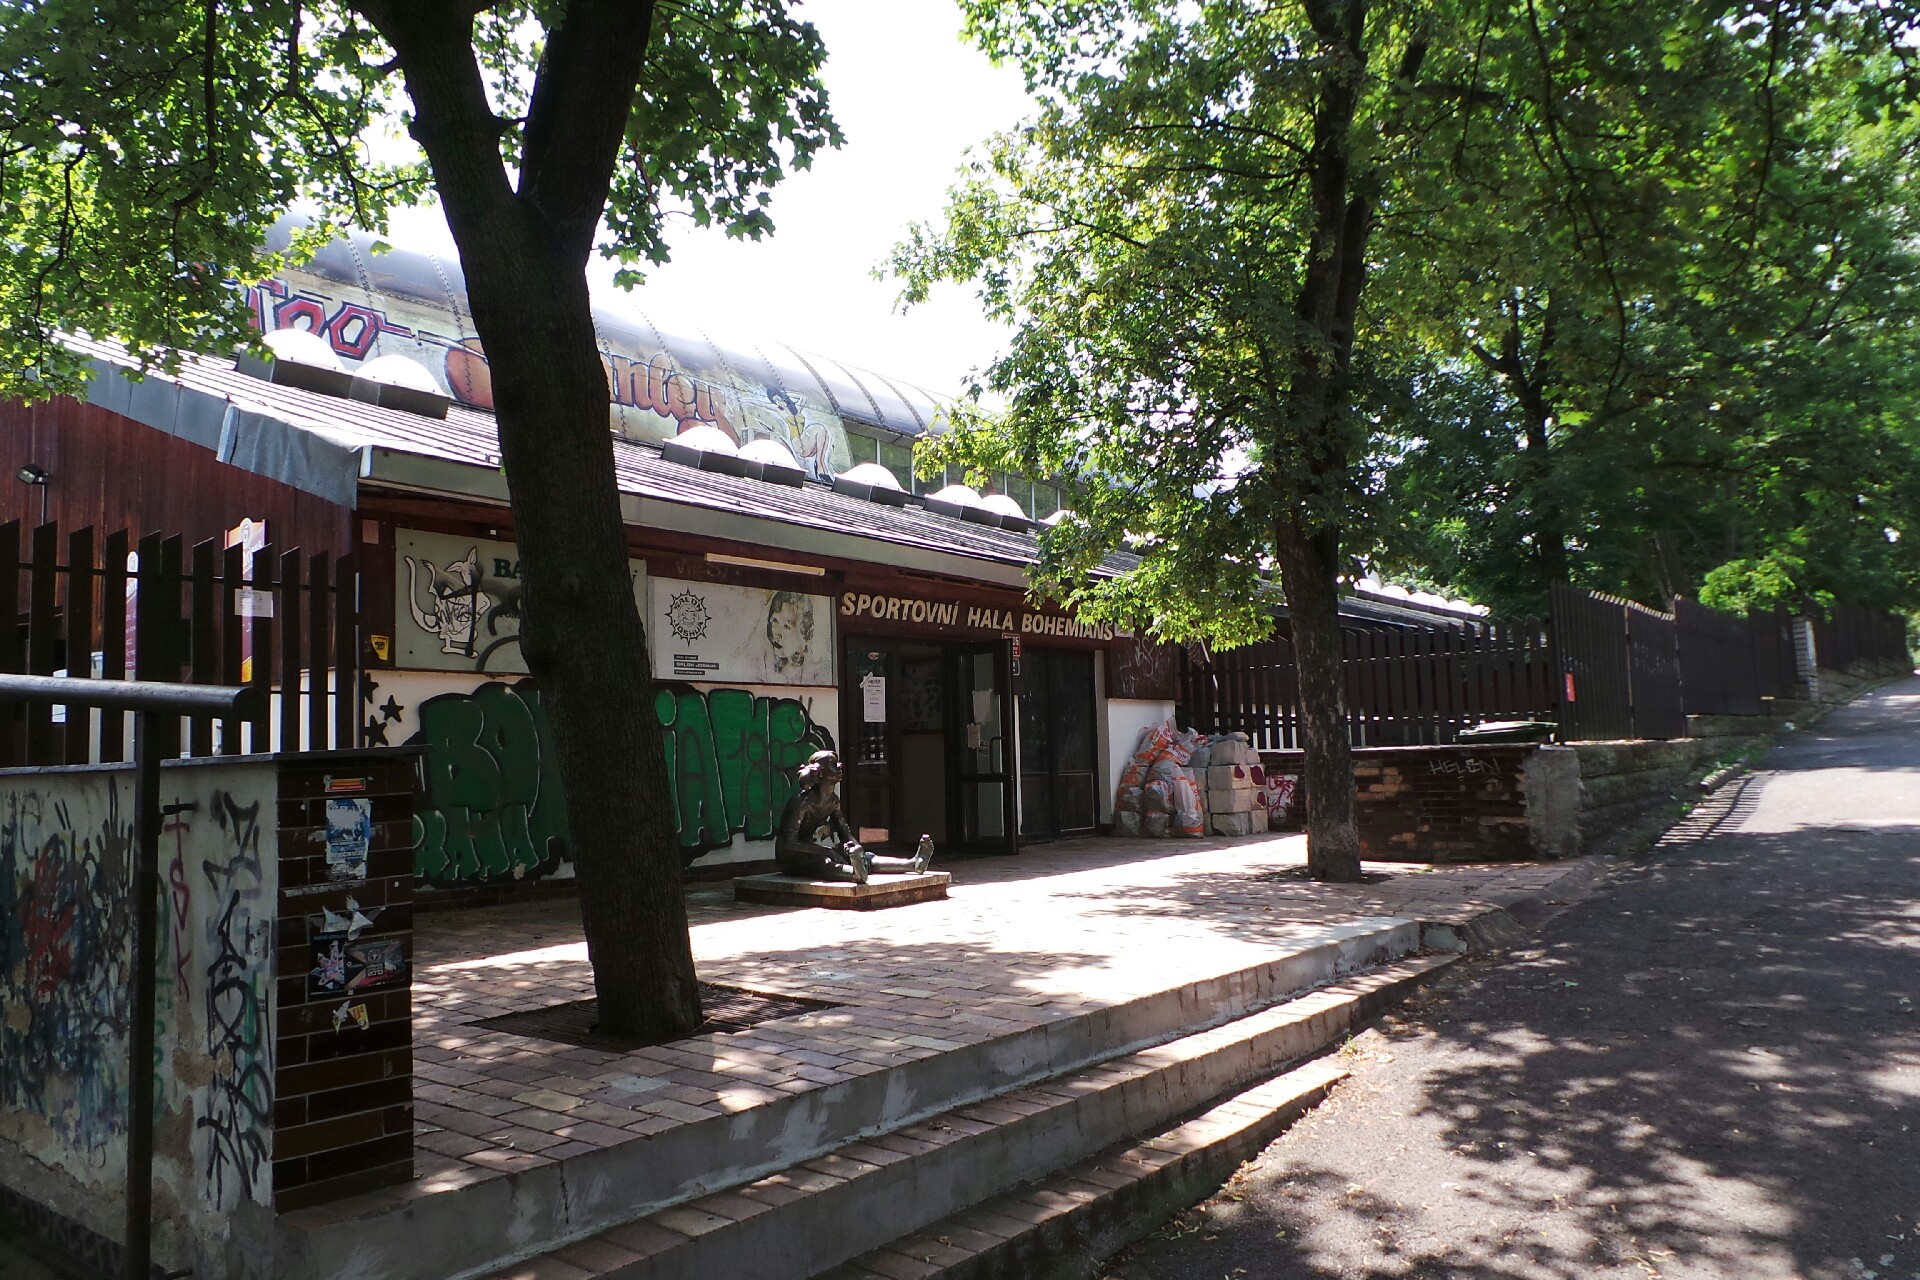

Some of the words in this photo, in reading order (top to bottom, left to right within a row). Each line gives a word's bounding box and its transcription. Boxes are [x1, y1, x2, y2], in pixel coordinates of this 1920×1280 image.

[840, 591, 960, 626] SPORTOVNÍ
[966, 606, 1014, 631] HALA
[1021, 612, 1114, 641] BOHEMIANS
